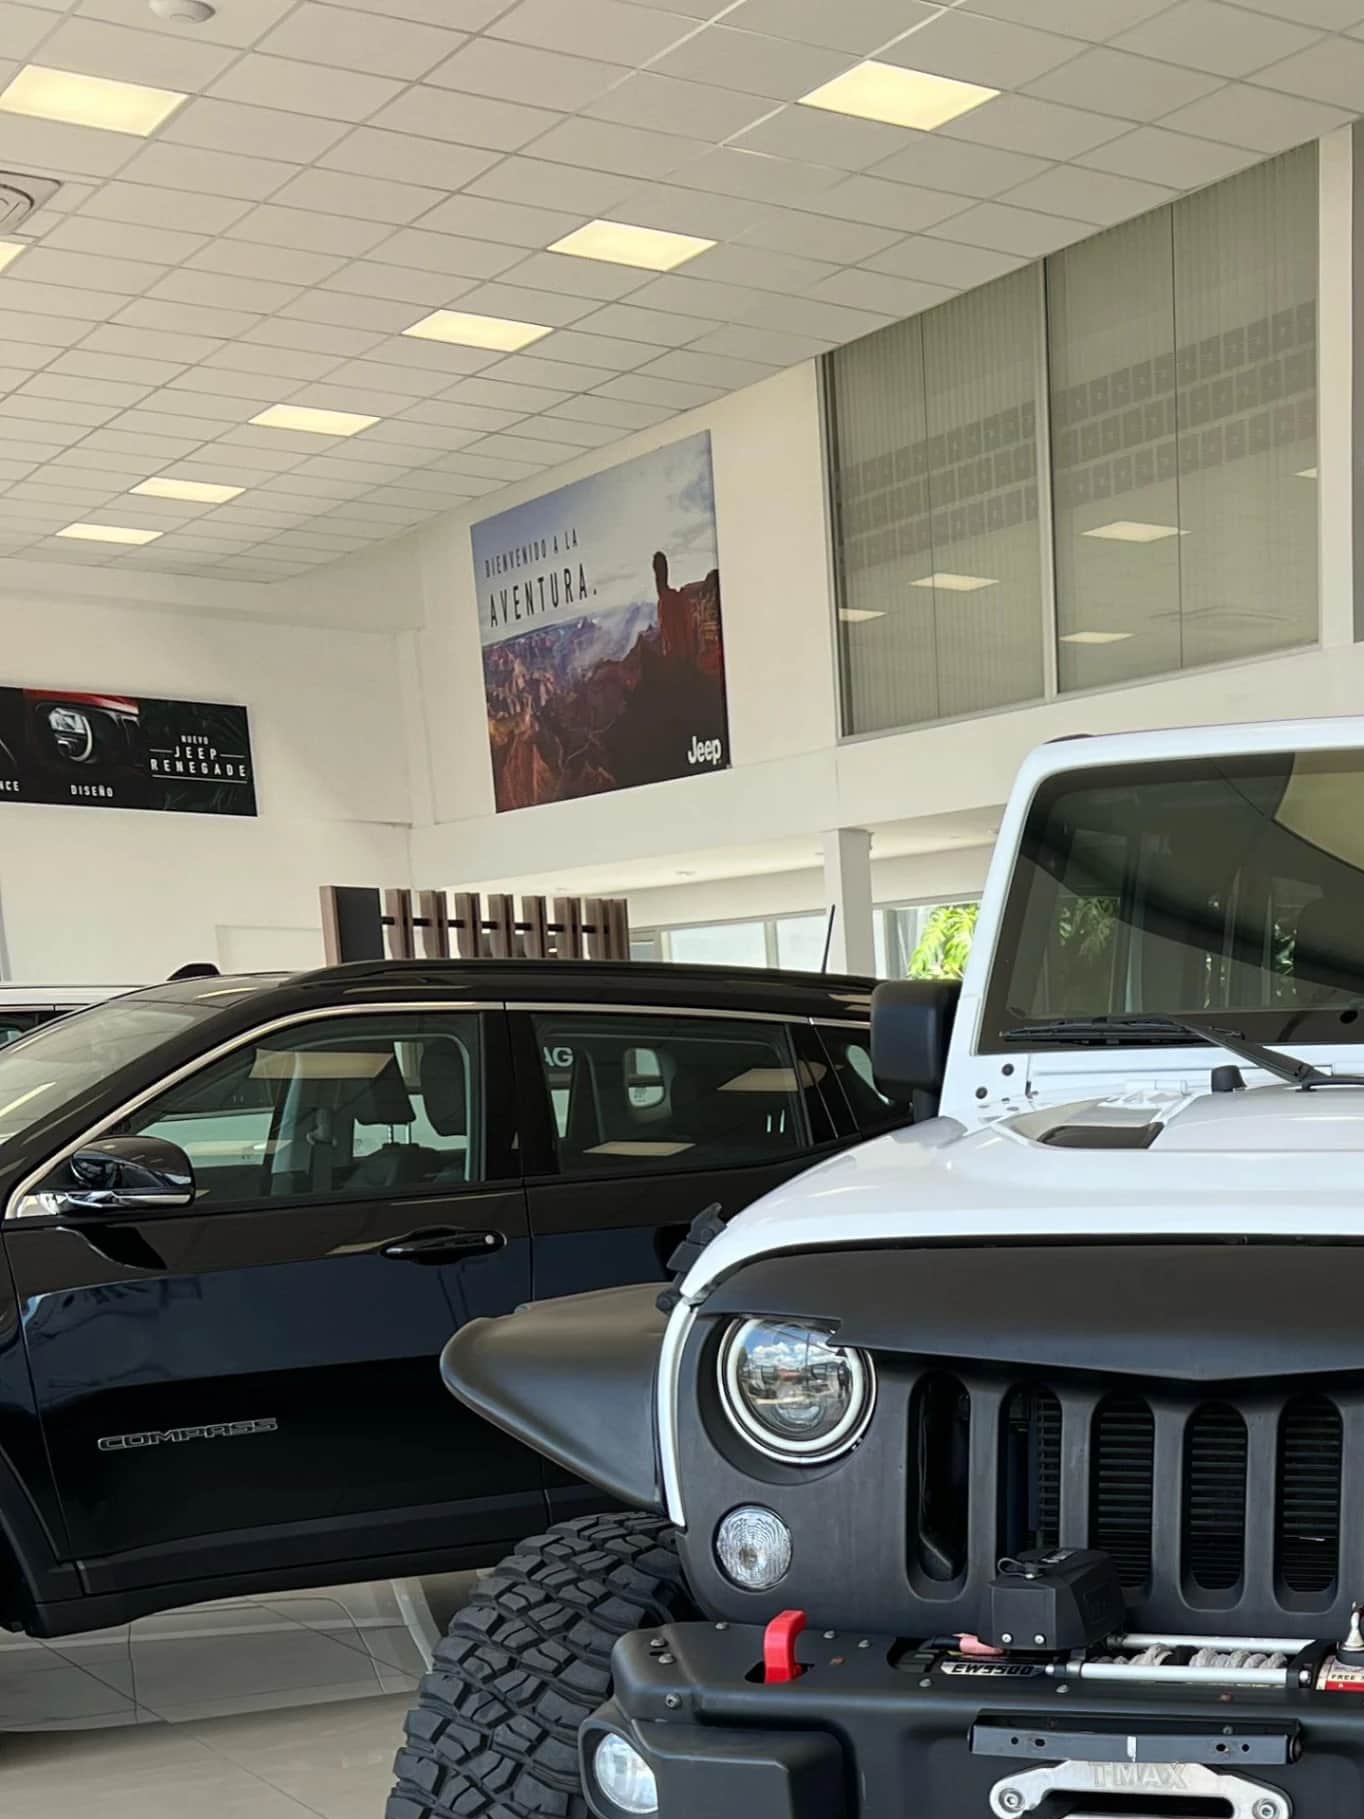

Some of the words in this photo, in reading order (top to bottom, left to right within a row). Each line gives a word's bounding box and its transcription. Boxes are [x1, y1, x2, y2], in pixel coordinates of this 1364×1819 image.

[484, 538, 546, 578] BIENVENIDO
[552, 535, 559, 554] A
[565, 527, 578, 551] LA
[489, 562, 598, 628] AVENTURA.
[180, 735, 208, 744] NUEVO
[687, 735, 722, 765] Jeep
[173, 745, 217, 760] JEEP
[150, 758, 247, 777] RENEGADE
[70, 784, 114, 797] DISEÑO
[97, 1417, 279, 1451] COMPASS
